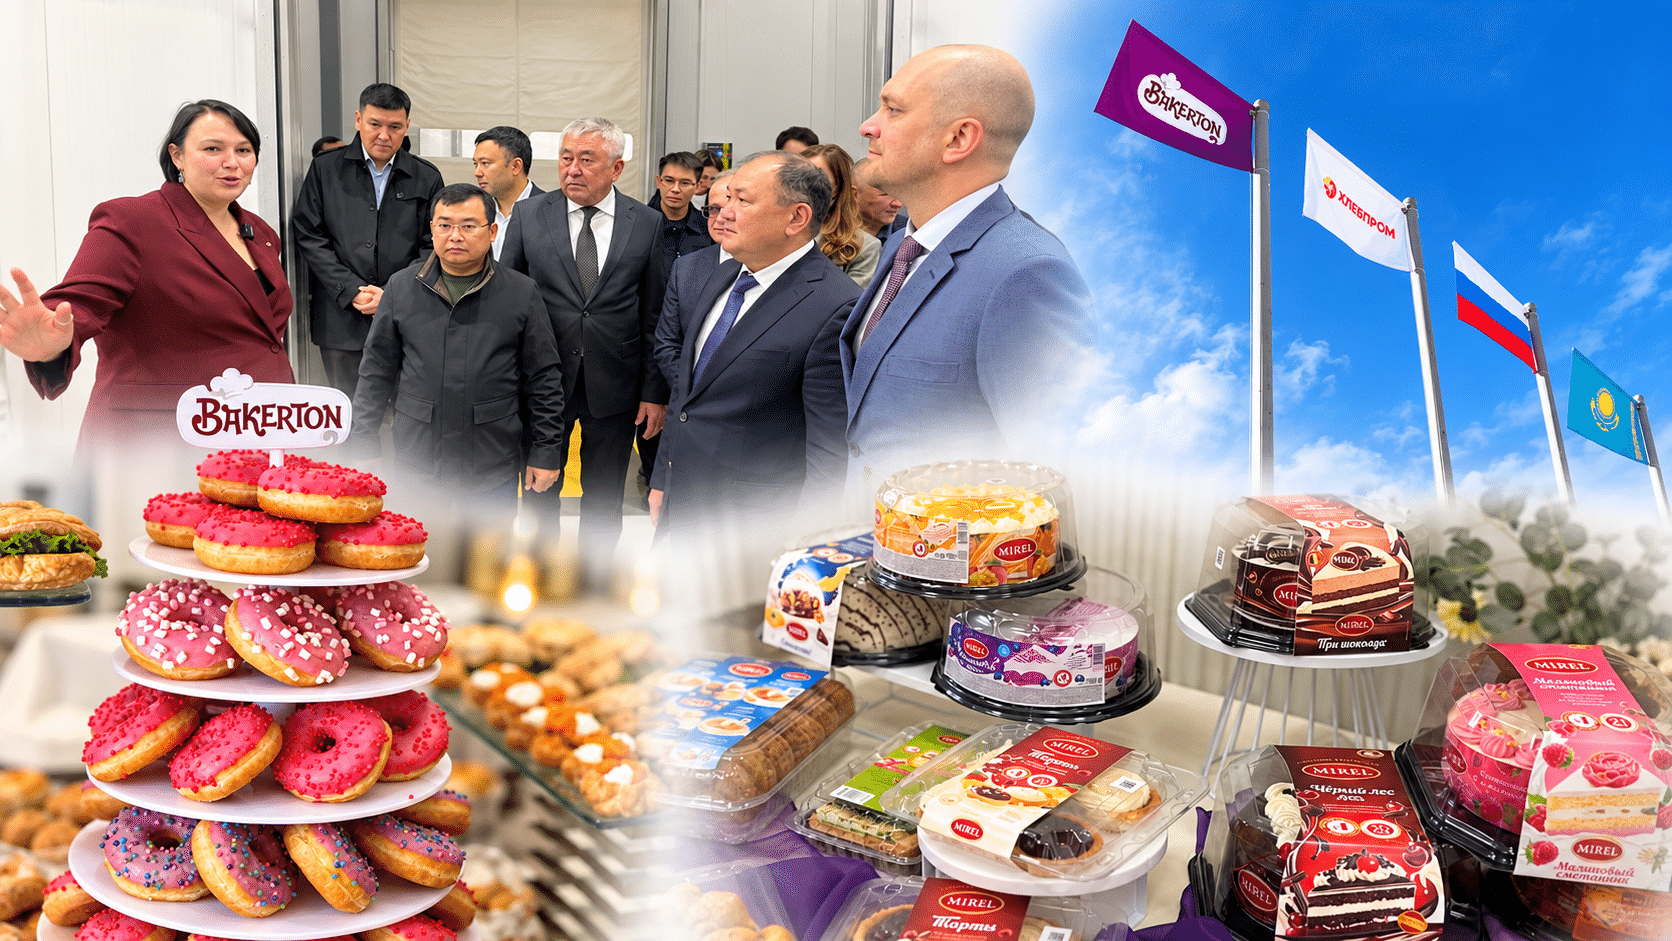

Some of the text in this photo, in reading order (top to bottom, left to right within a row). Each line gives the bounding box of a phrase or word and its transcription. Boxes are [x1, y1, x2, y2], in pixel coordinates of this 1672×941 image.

[1144, 80, 1222, 139] BAKERTON
[1337, 190, 1396, 240] ХЛЕБПРОМ
[191, 398, 343, 437] BAKERTON
[998, 543, 1034, 557] MIREL
[1533, 661, 1591, 670] MIREL
[1312, 766, 1374, 776] MIREL
[953, 822, 981, 838] MIREL
[1577, 843, 1619, 857] MIREL
[947, 896, 997, 909] MIREL
